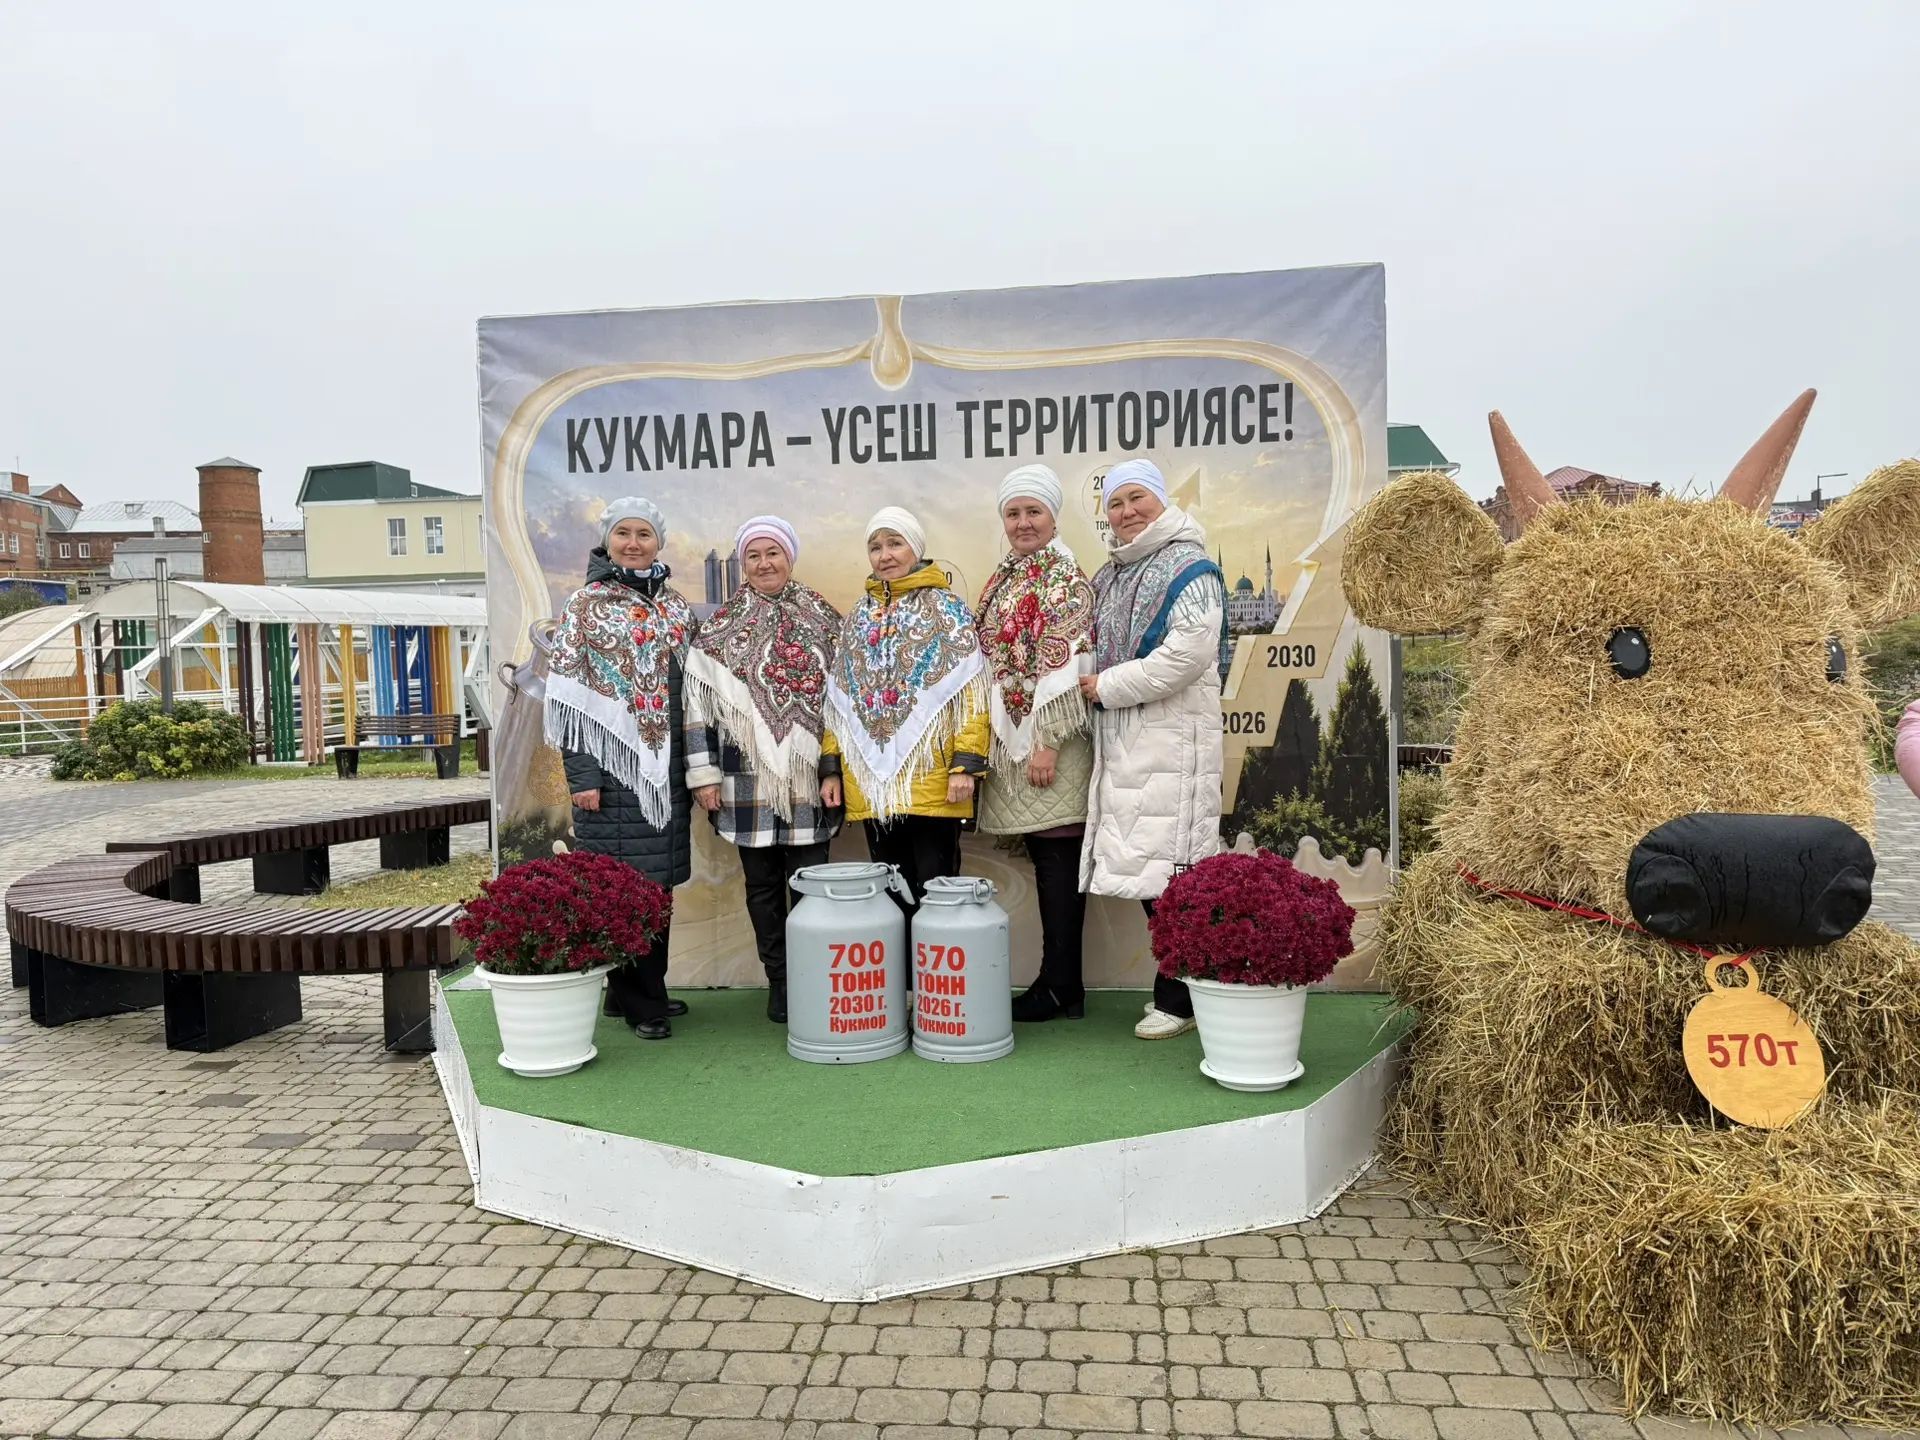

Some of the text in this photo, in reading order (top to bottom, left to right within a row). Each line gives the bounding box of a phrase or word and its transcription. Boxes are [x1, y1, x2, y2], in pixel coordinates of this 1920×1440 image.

[567, 411, 775, 473] КУКМАРА
[821, 403, 937, 464] ҮСЕШ
[956, 383, 1294, 459] ТЕРРИТОРИЯСЕ!
[1267, 645, 1316, 668] 2030
[829, 940, 885, 968] 700
[917, 942, 966, 971] 570
[829, 995, 875, 1014] 2030
[917, 994, 951, 1017] 2026
[830, 1014, 886, 1033] Кукмор
[917, 1013, 966, 1036] Кукмор
